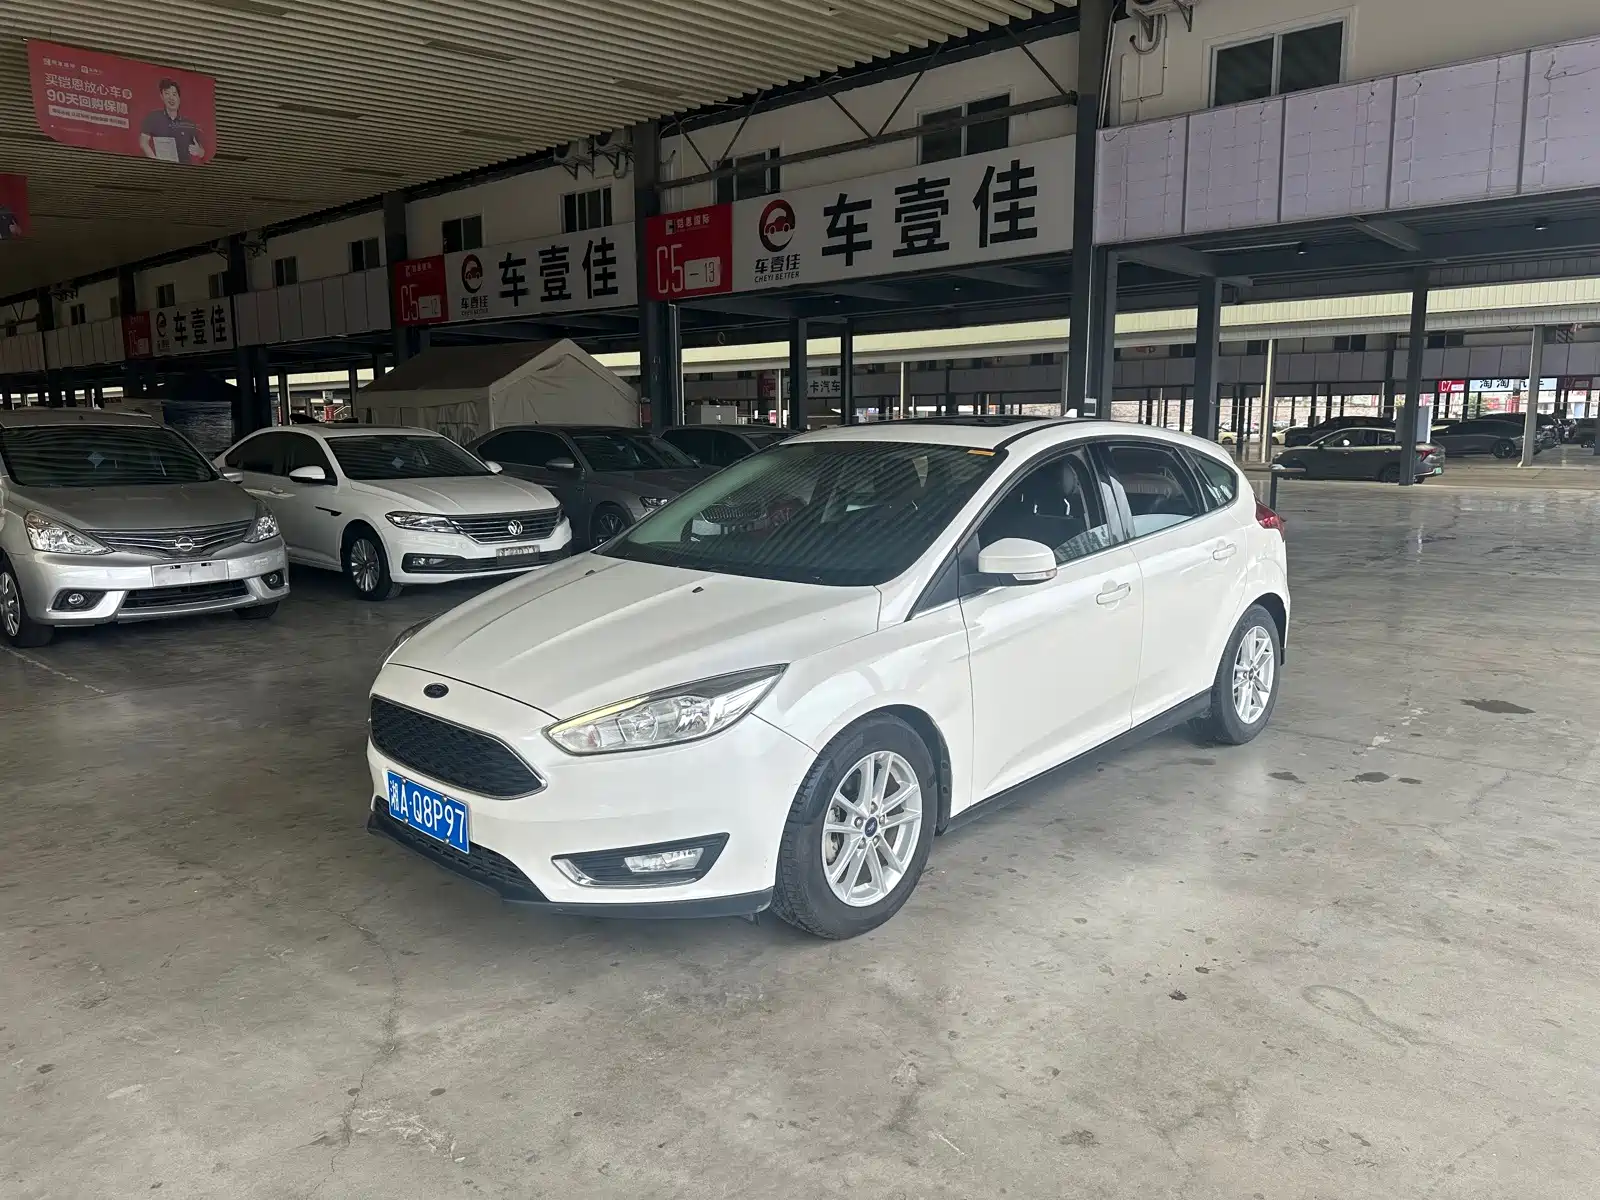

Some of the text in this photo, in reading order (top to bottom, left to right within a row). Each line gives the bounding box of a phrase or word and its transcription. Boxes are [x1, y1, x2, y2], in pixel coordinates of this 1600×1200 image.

[46, 89, 128, 114] 90天回购保障
[822, 159, 1038, 267] 车壹佳
[498, 236, 618, 307] 车壹佳
[656, 243, 683, 294] C5
[754, 271, 800, 283] CHEYI BETTER
[755, 253, 801, 274] 车壹佳
[173, 304, 227, 347] 车壹佳
[1441, 380, 1452, 392] C7
